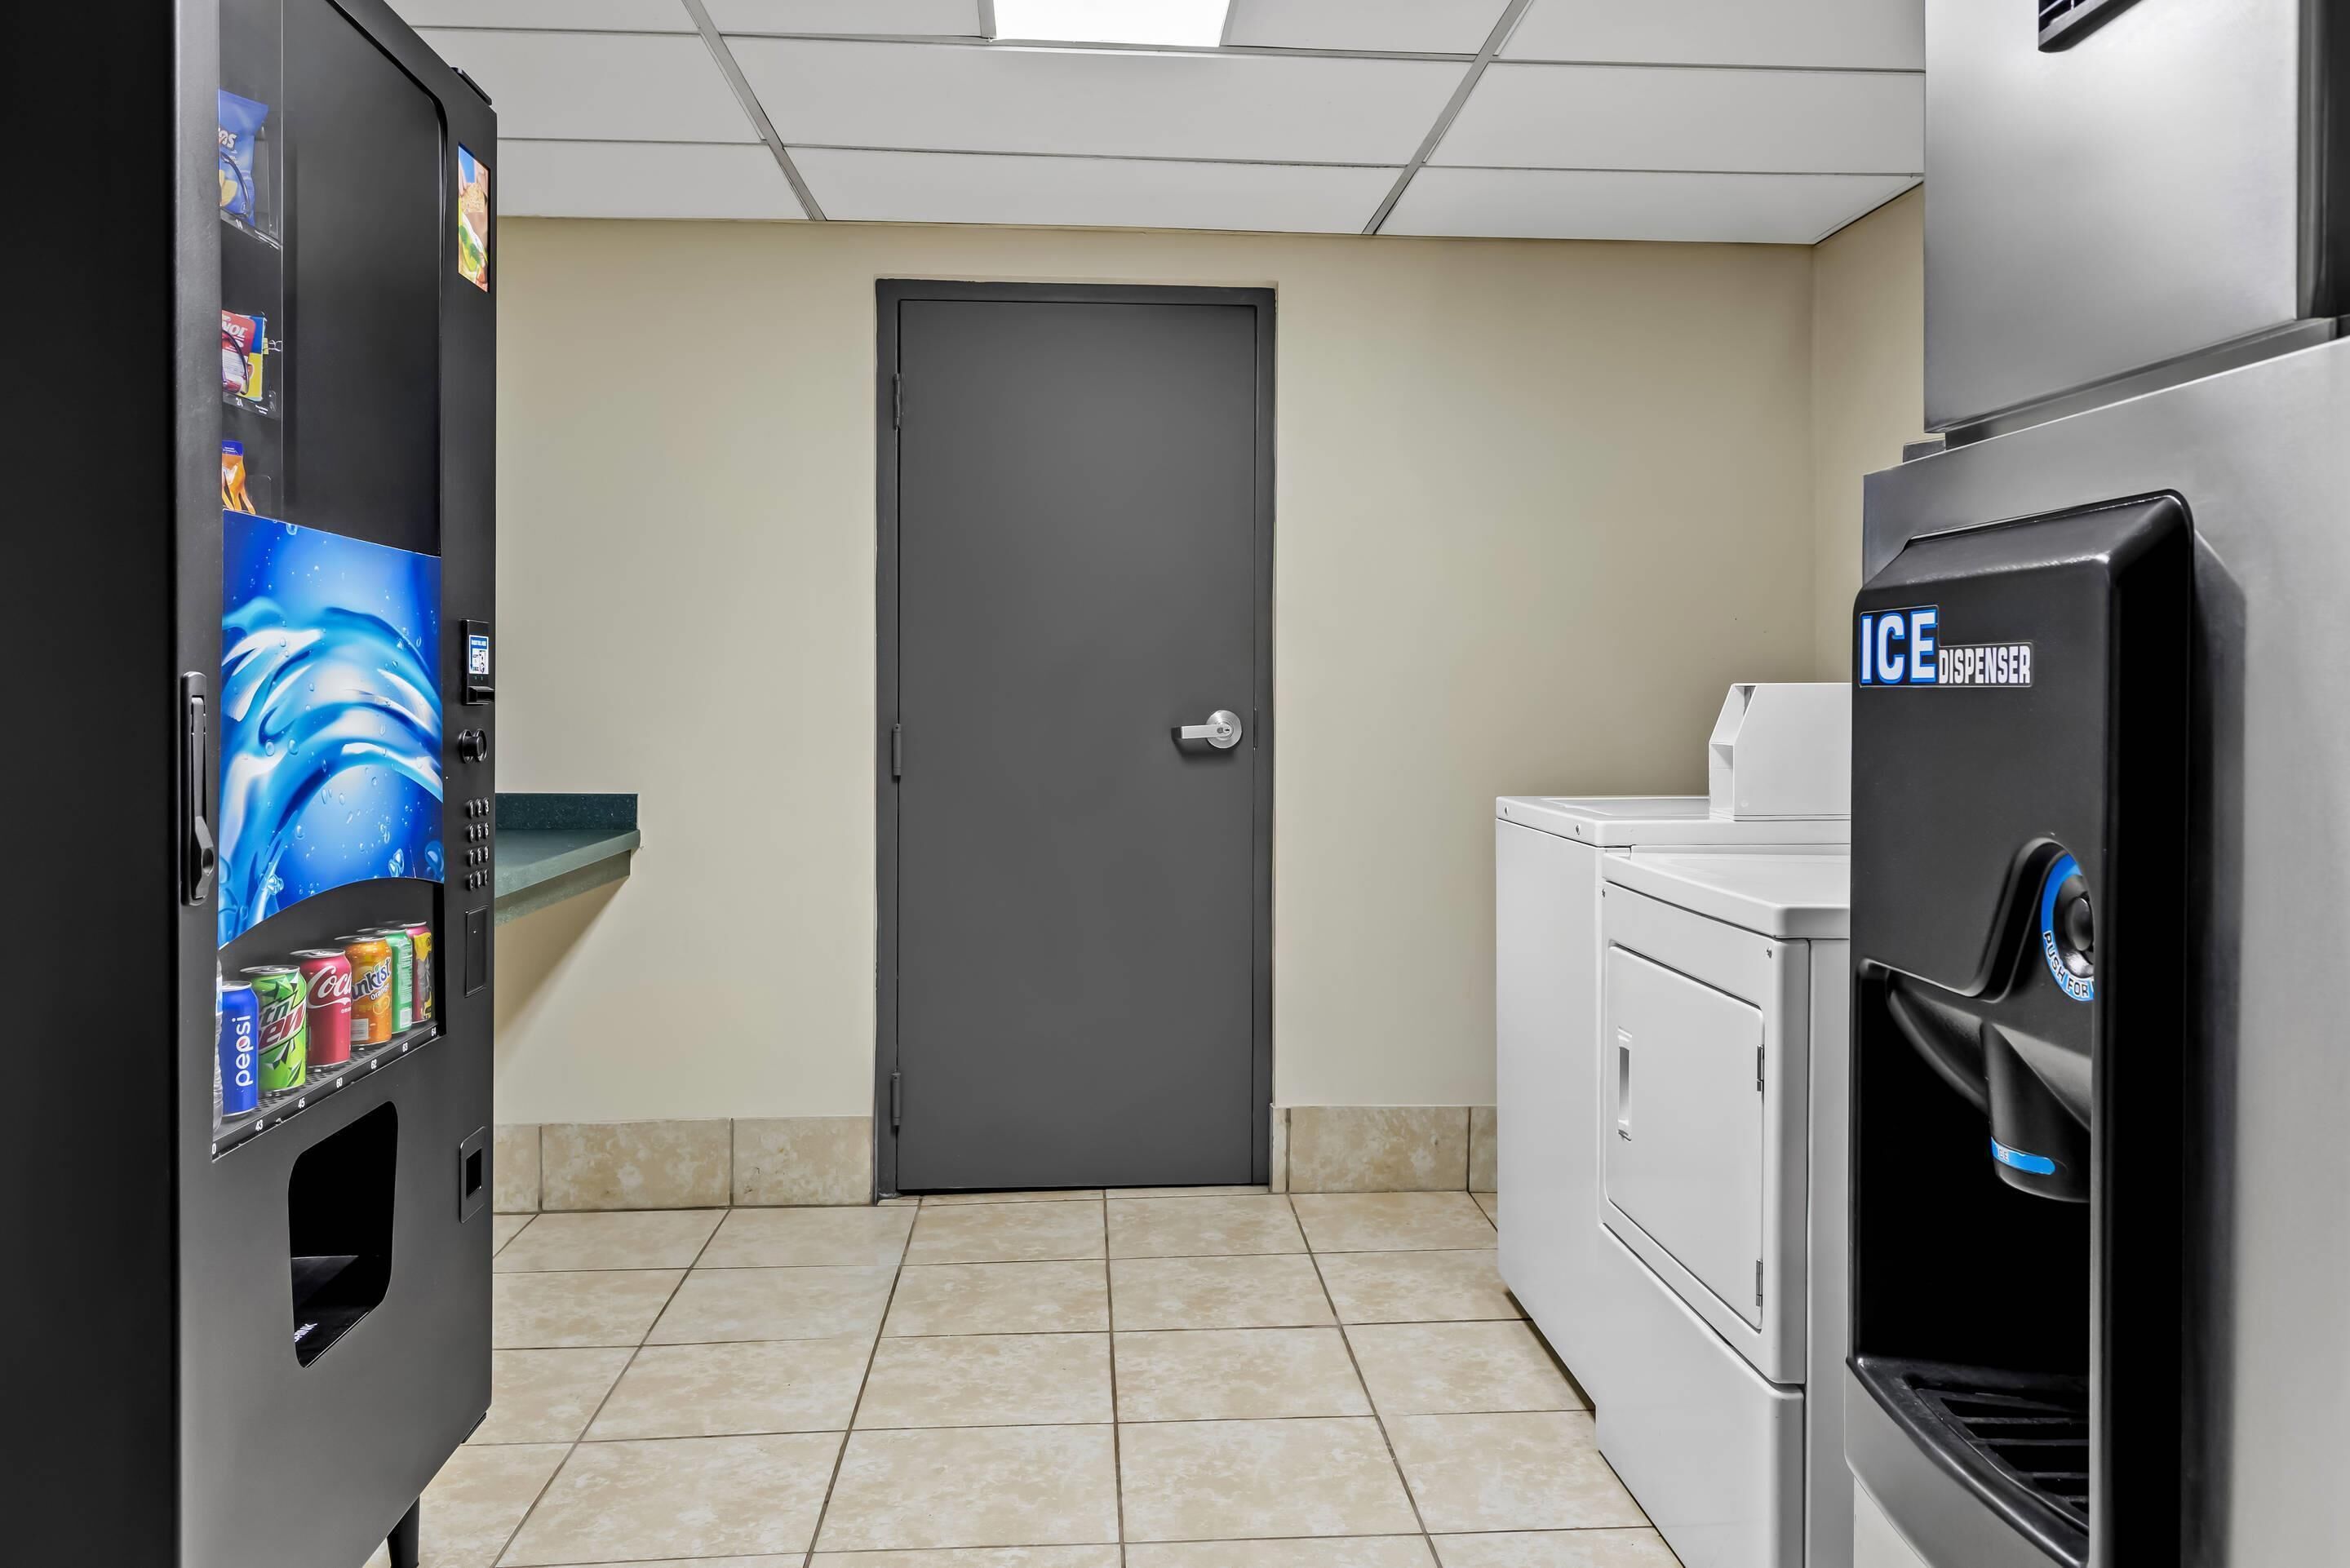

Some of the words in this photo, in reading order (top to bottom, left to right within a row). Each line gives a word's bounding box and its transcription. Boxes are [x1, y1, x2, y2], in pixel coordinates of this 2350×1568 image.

[1860, 609, 1937, 683] ICE
[1938, 645, 2031, 684] DISPENSER
[2043, 931, 2066, 983] PUSH
[2066, 977, 2090, 997] FOR
[351, 957, 392, 1001] unkist
[259, 1000, 290, 1029] tn
[232, 1015, 254, 1087] pepsi
[370, 1058, 377, 1070] 62
[336, 1077, 343, 1088] 60
[298, 1097, 305, 1109] 45
[255, 1119, 263, 1132] 43
